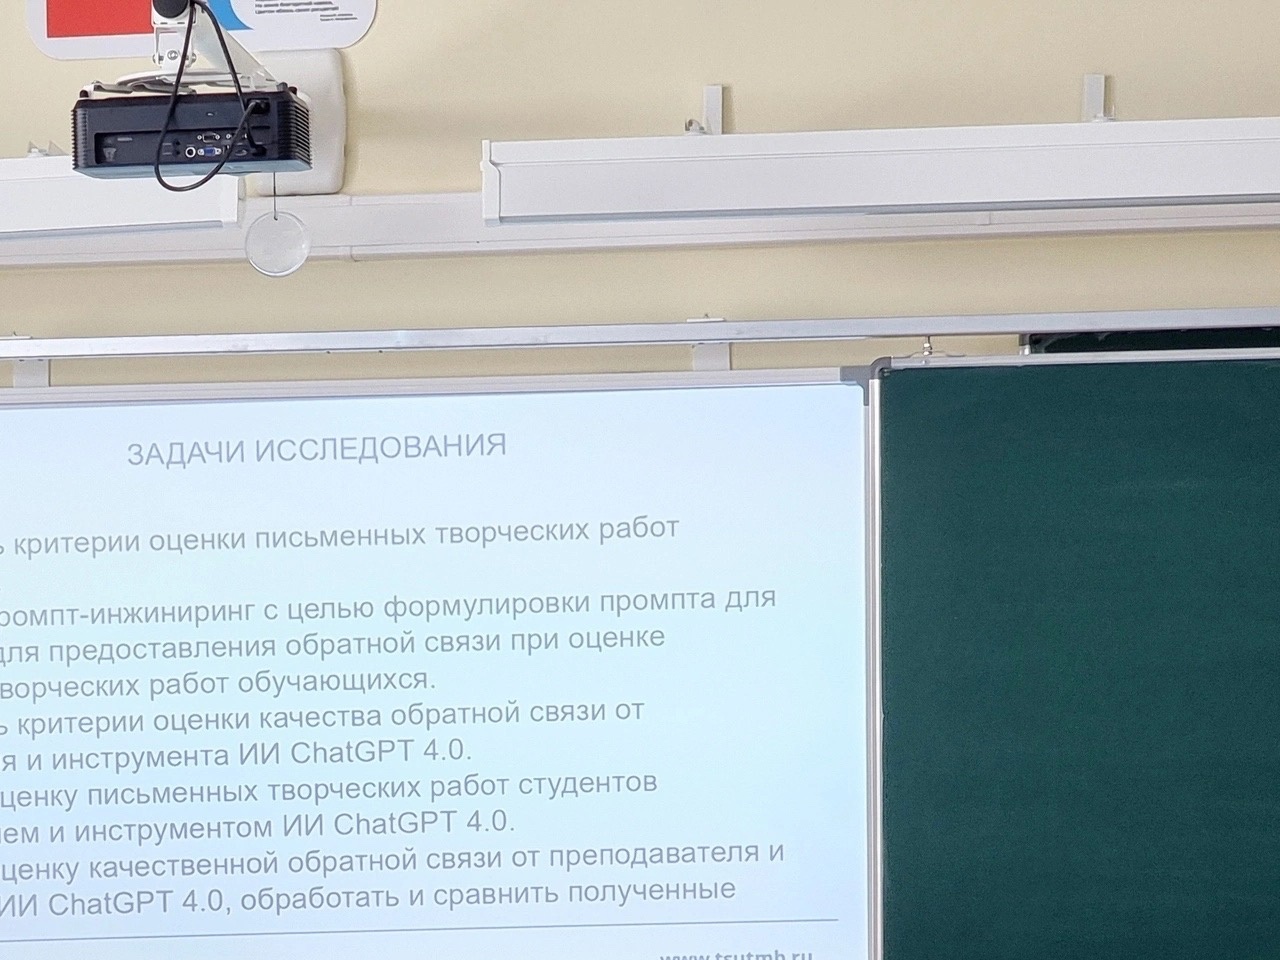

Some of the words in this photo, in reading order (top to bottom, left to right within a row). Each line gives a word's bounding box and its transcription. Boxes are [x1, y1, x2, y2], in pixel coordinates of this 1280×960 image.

[127, 439, 245, 471] ЗАДАЧИ
[255, 432, 506, 466] ИССЛЕДОВАНИЯ
[14, 534, 140, 561] критерии
[148, 531, 246, 556] оценки
[255, 527, 427, 549] письменных
[434, 522, 590, 550] творческих
[599, 514, 680, 546] работ
[263, 603, 279, 621] с
[287, 600, 374, 625] целью
[383, 594, 590, 624] формулировки
[600, 591, 716, 618] промпта
[724, 589, 776, 613] для
[49, 639, 276, 668] предоставления
[285, 629, 415, 662] обратной
[424, 633, 501, 653] связи
[511, 632, 559, 657] при
[568, 629, 666, 653] оценке
[149, 670, 230, 702] работ
[237, 669, 436, 699] обучающихся.
[17, 714, 144, 742] критерии
[153, 711, 250, 736] оценки
[259, 709, 382, 729] качества
[390, 699, 520, 732] обратной
[529, 703, 606, 723] связи
[615, 702, 646, 721] от
[27, 753, 42, 771] и
[52, 748, 229, 775] инструмента
[239, 741, 280, 766] ИИ
[290, 738, 416, 765] ChatGPT
[423, 737, 472, 761] 4.0.
[87, 784, 259, 806] письменных
[266, 780, 422, 807] творческих
[430, 772, 510, 804] работ
[518, 774, 658, 801] студентов
[49, 825, 65, 844] и
[75, 819, 273, 848] инструментом
[283, 813, 324, 838] ИИ
[333, 809, 459, 836] ChatGPT
[466, 808, 515, 833] 4.0.
[89, 850, 278, 879] качественной
[287, 846, 417, 879] обратной
[426, 850, 502, 870] связи
[511, 849, 541, 868] от
[549, 844, 759, 873] преподавателя
[769, 843, 784, 862] и
[48, 889, 175, 917] ChatGPT
[181, 888, 231, 916] 4.0,
[240, 885, 400, 917] обработать
[409, 888, 424, 907] и
[433, 885, 559, 912] сравнить
[568, 881, 736, 908] полученные
